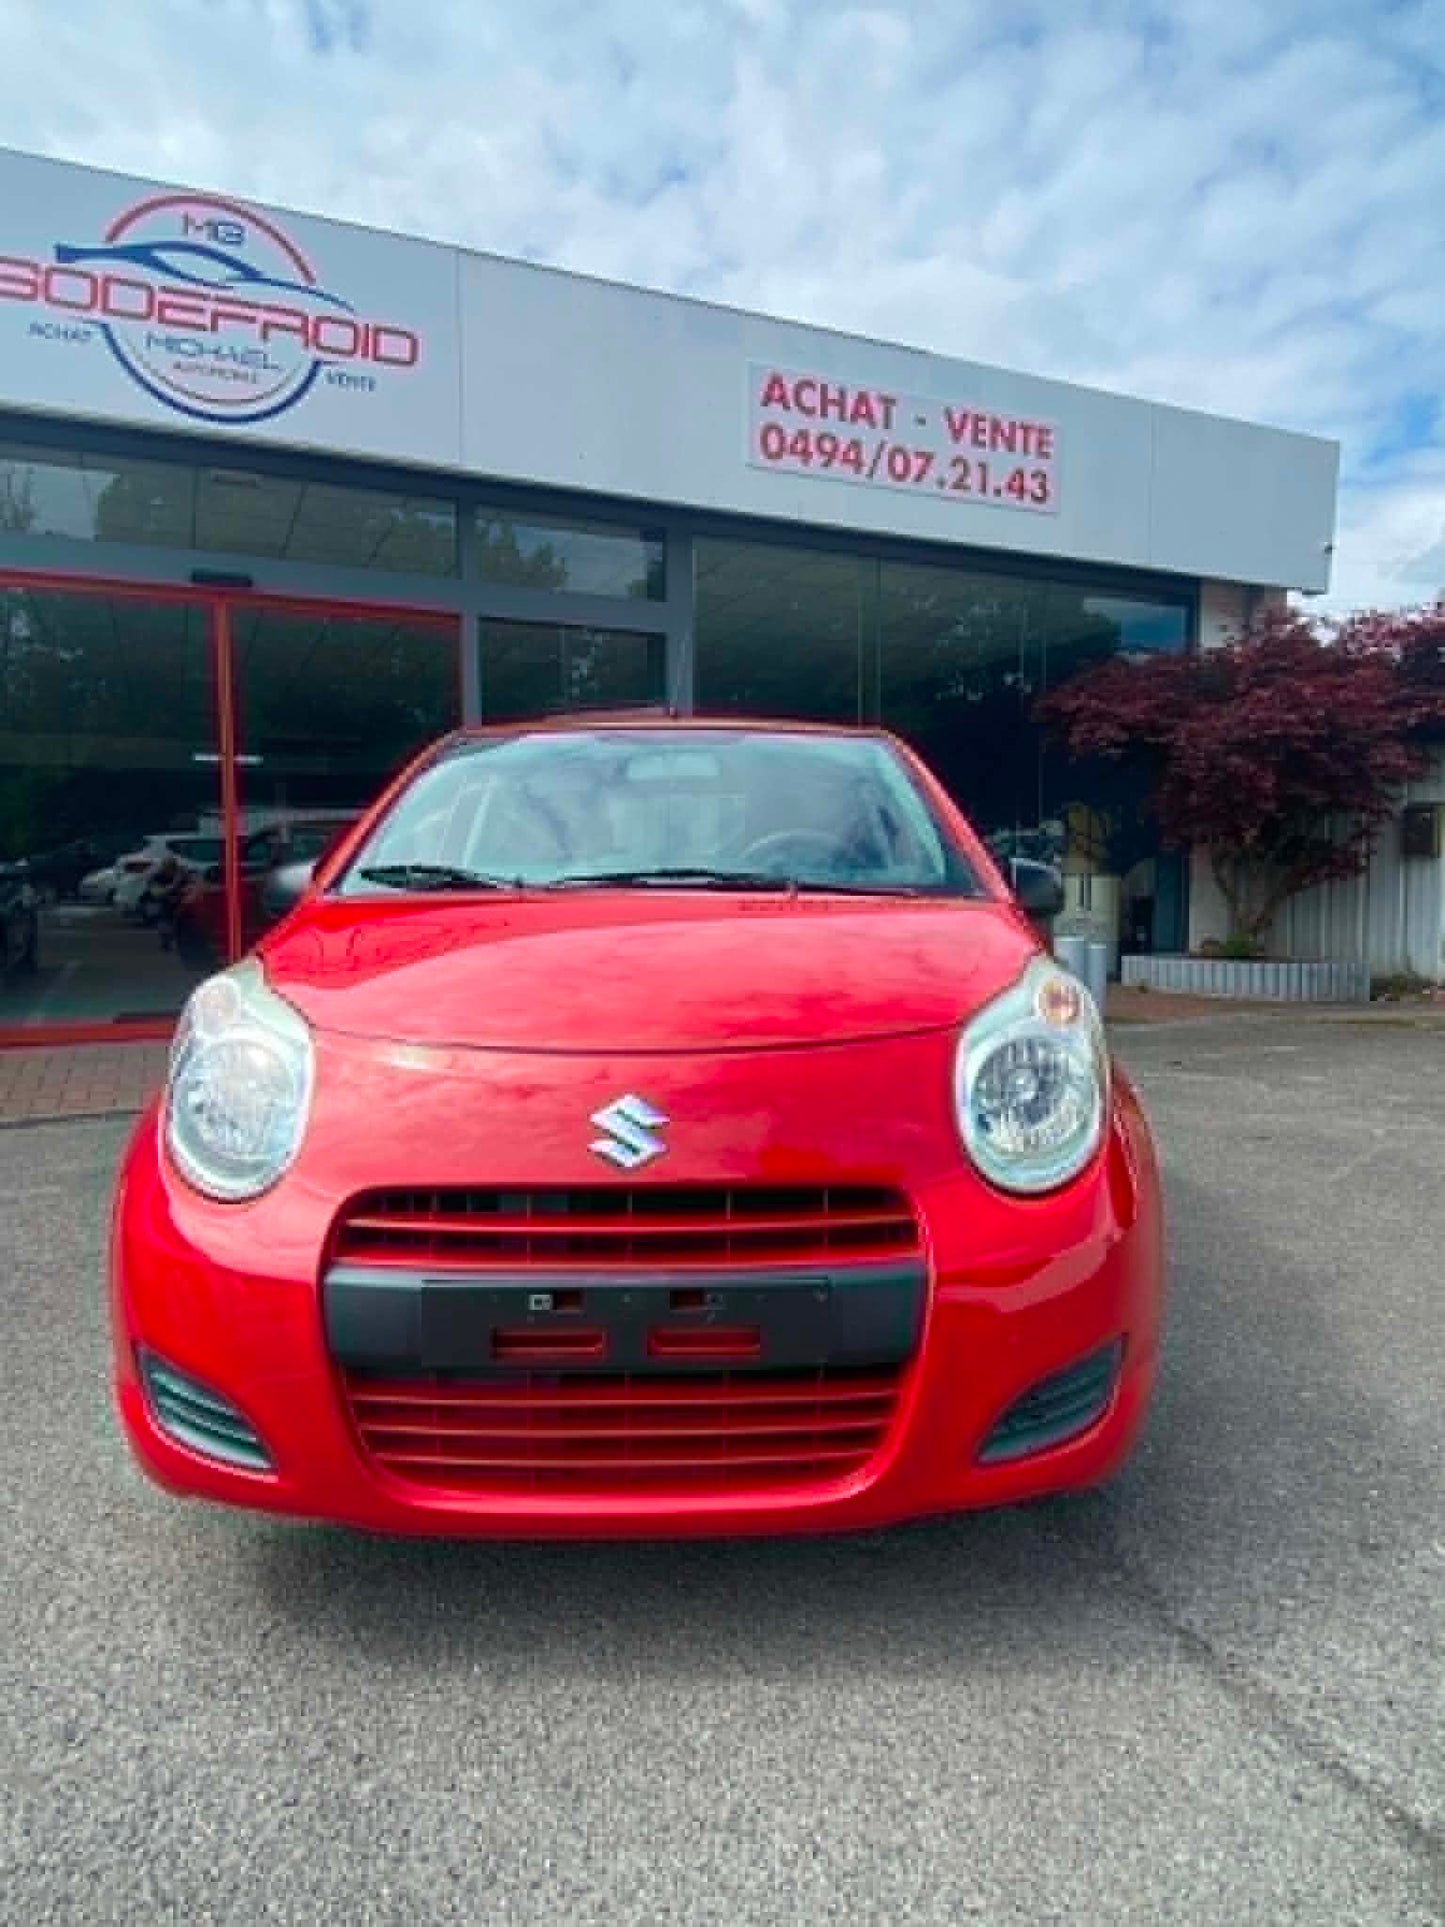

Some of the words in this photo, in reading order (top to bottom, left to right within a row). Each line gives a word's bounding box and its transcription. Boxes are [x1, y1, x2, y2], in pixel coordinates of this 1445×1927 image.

[760, 371, 897, 430] ACHAT
[943, 405, 1054, 459] VENTE
[760, 421, 1050, 504] 0494/07.21.43
